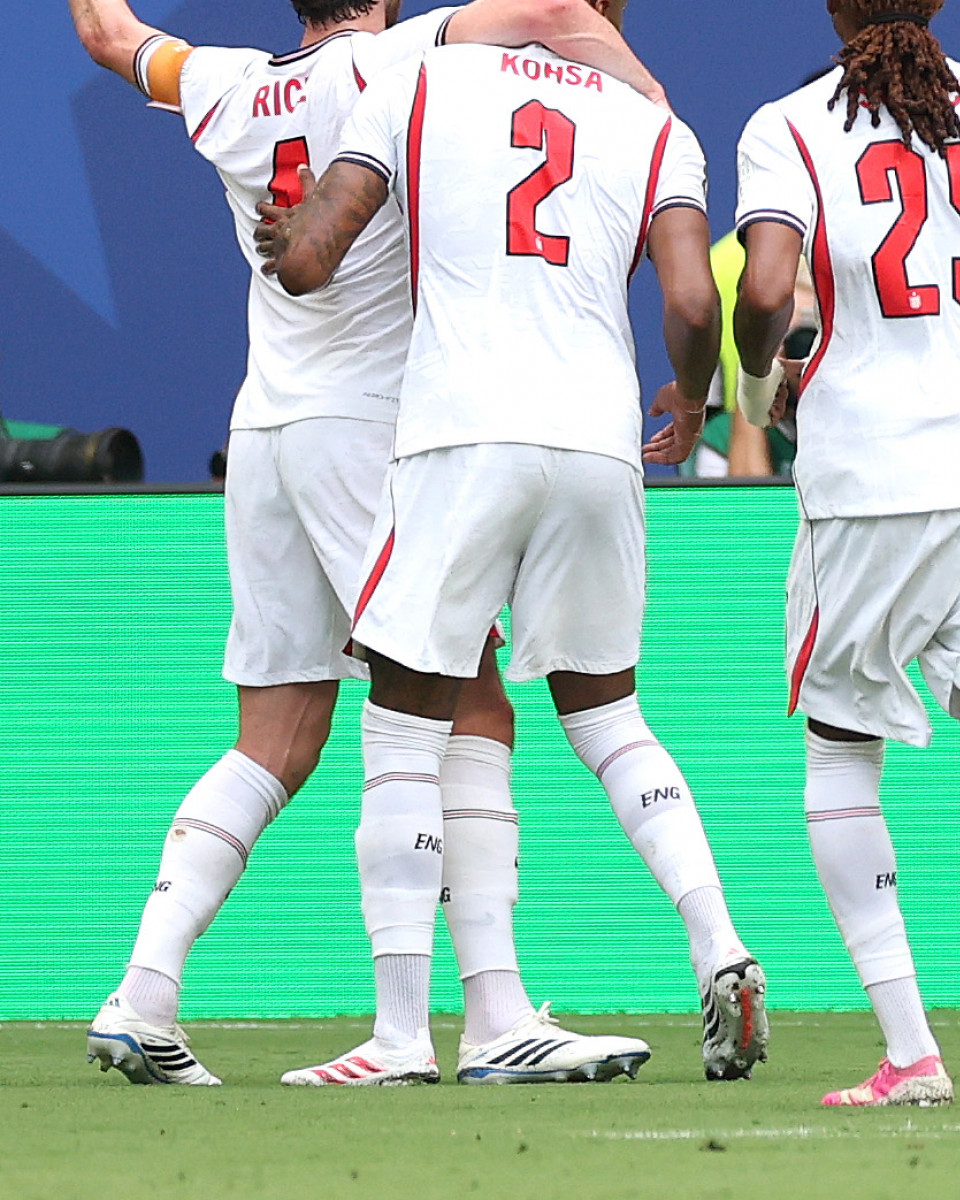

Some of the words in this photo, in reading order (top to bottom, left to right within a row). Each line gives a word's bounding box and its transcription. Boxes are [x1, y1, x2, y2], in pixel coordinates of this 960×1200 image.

[252, 78, 307, 117] RIC
[506, 99, 576, 267] 2
[640, 786, 681, 808] ENG
[414, 833, 443, 854] ENG
